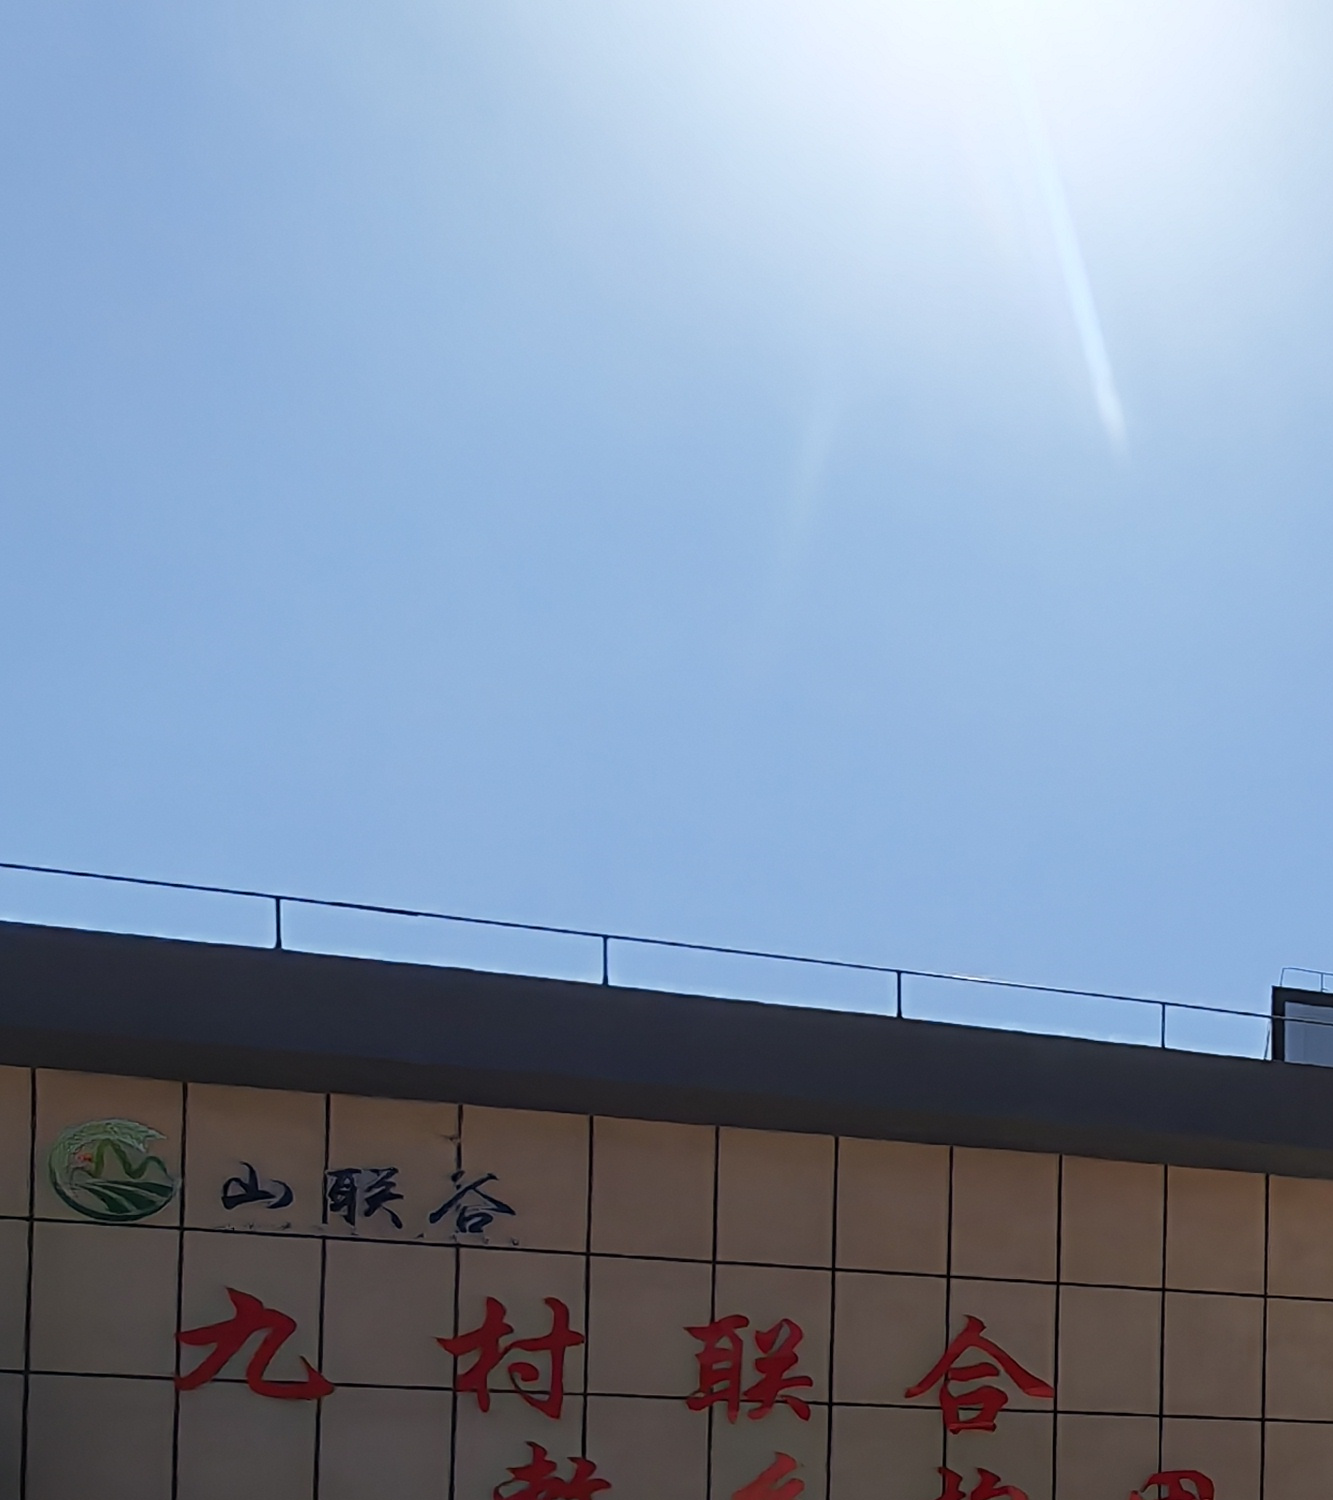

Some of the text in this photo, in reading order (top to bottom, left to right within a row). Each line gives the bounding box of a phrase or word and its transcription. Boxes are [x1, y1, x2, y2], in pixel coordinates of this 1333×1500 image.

[221, 1161, 517, 1234] 山联谷
[175, 1287, 1056, 1435] 九村联合
